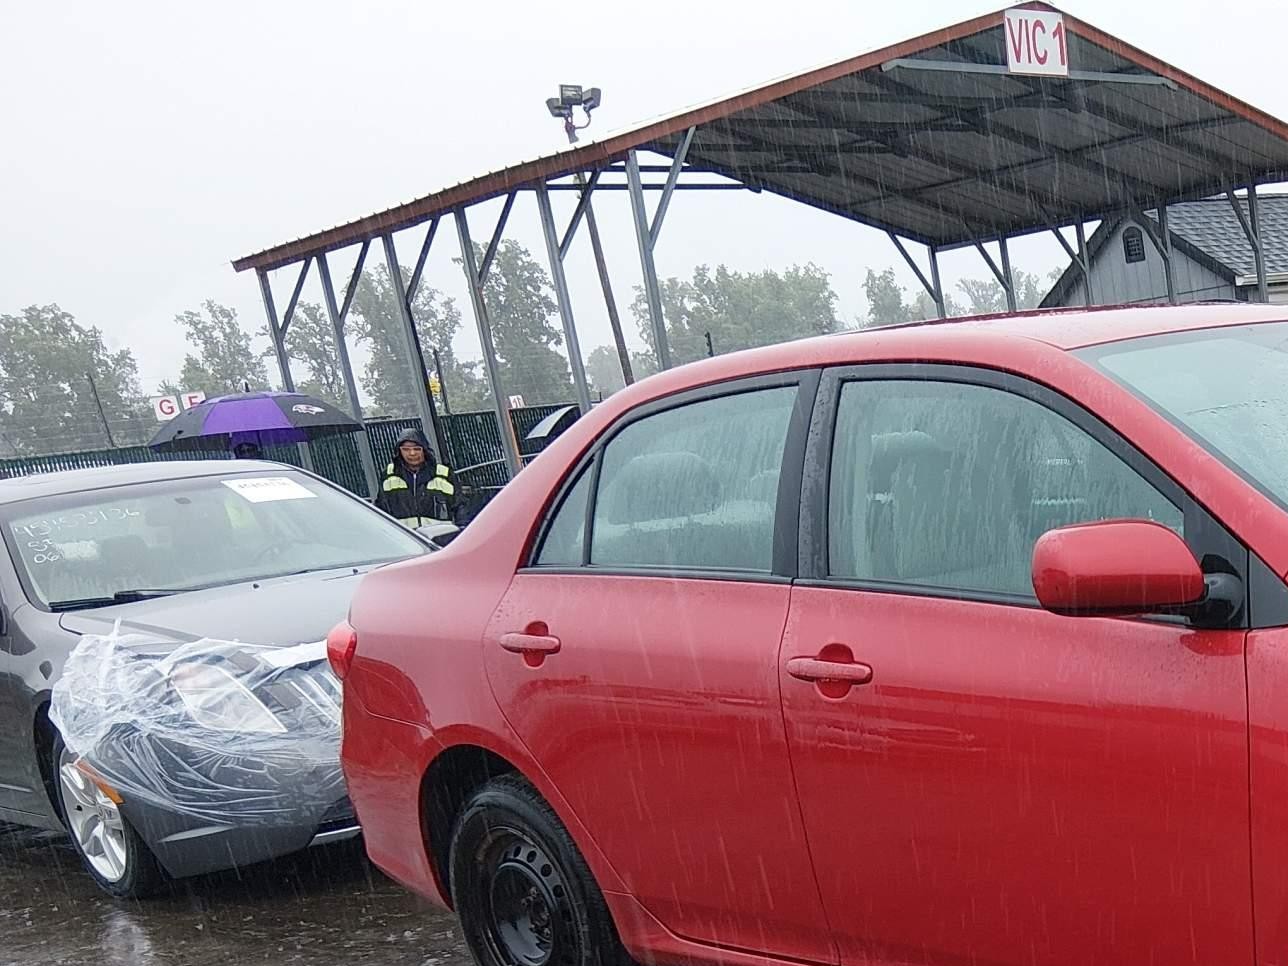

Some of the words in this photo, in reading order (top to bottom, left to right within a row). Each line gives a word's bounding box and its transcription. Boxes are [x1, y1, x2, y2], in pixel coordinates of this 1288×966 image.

[1006, 17, 1048, 65] VIC
[1052, 21, 1066, 66] 1
[159, 399, 175, 415] G
